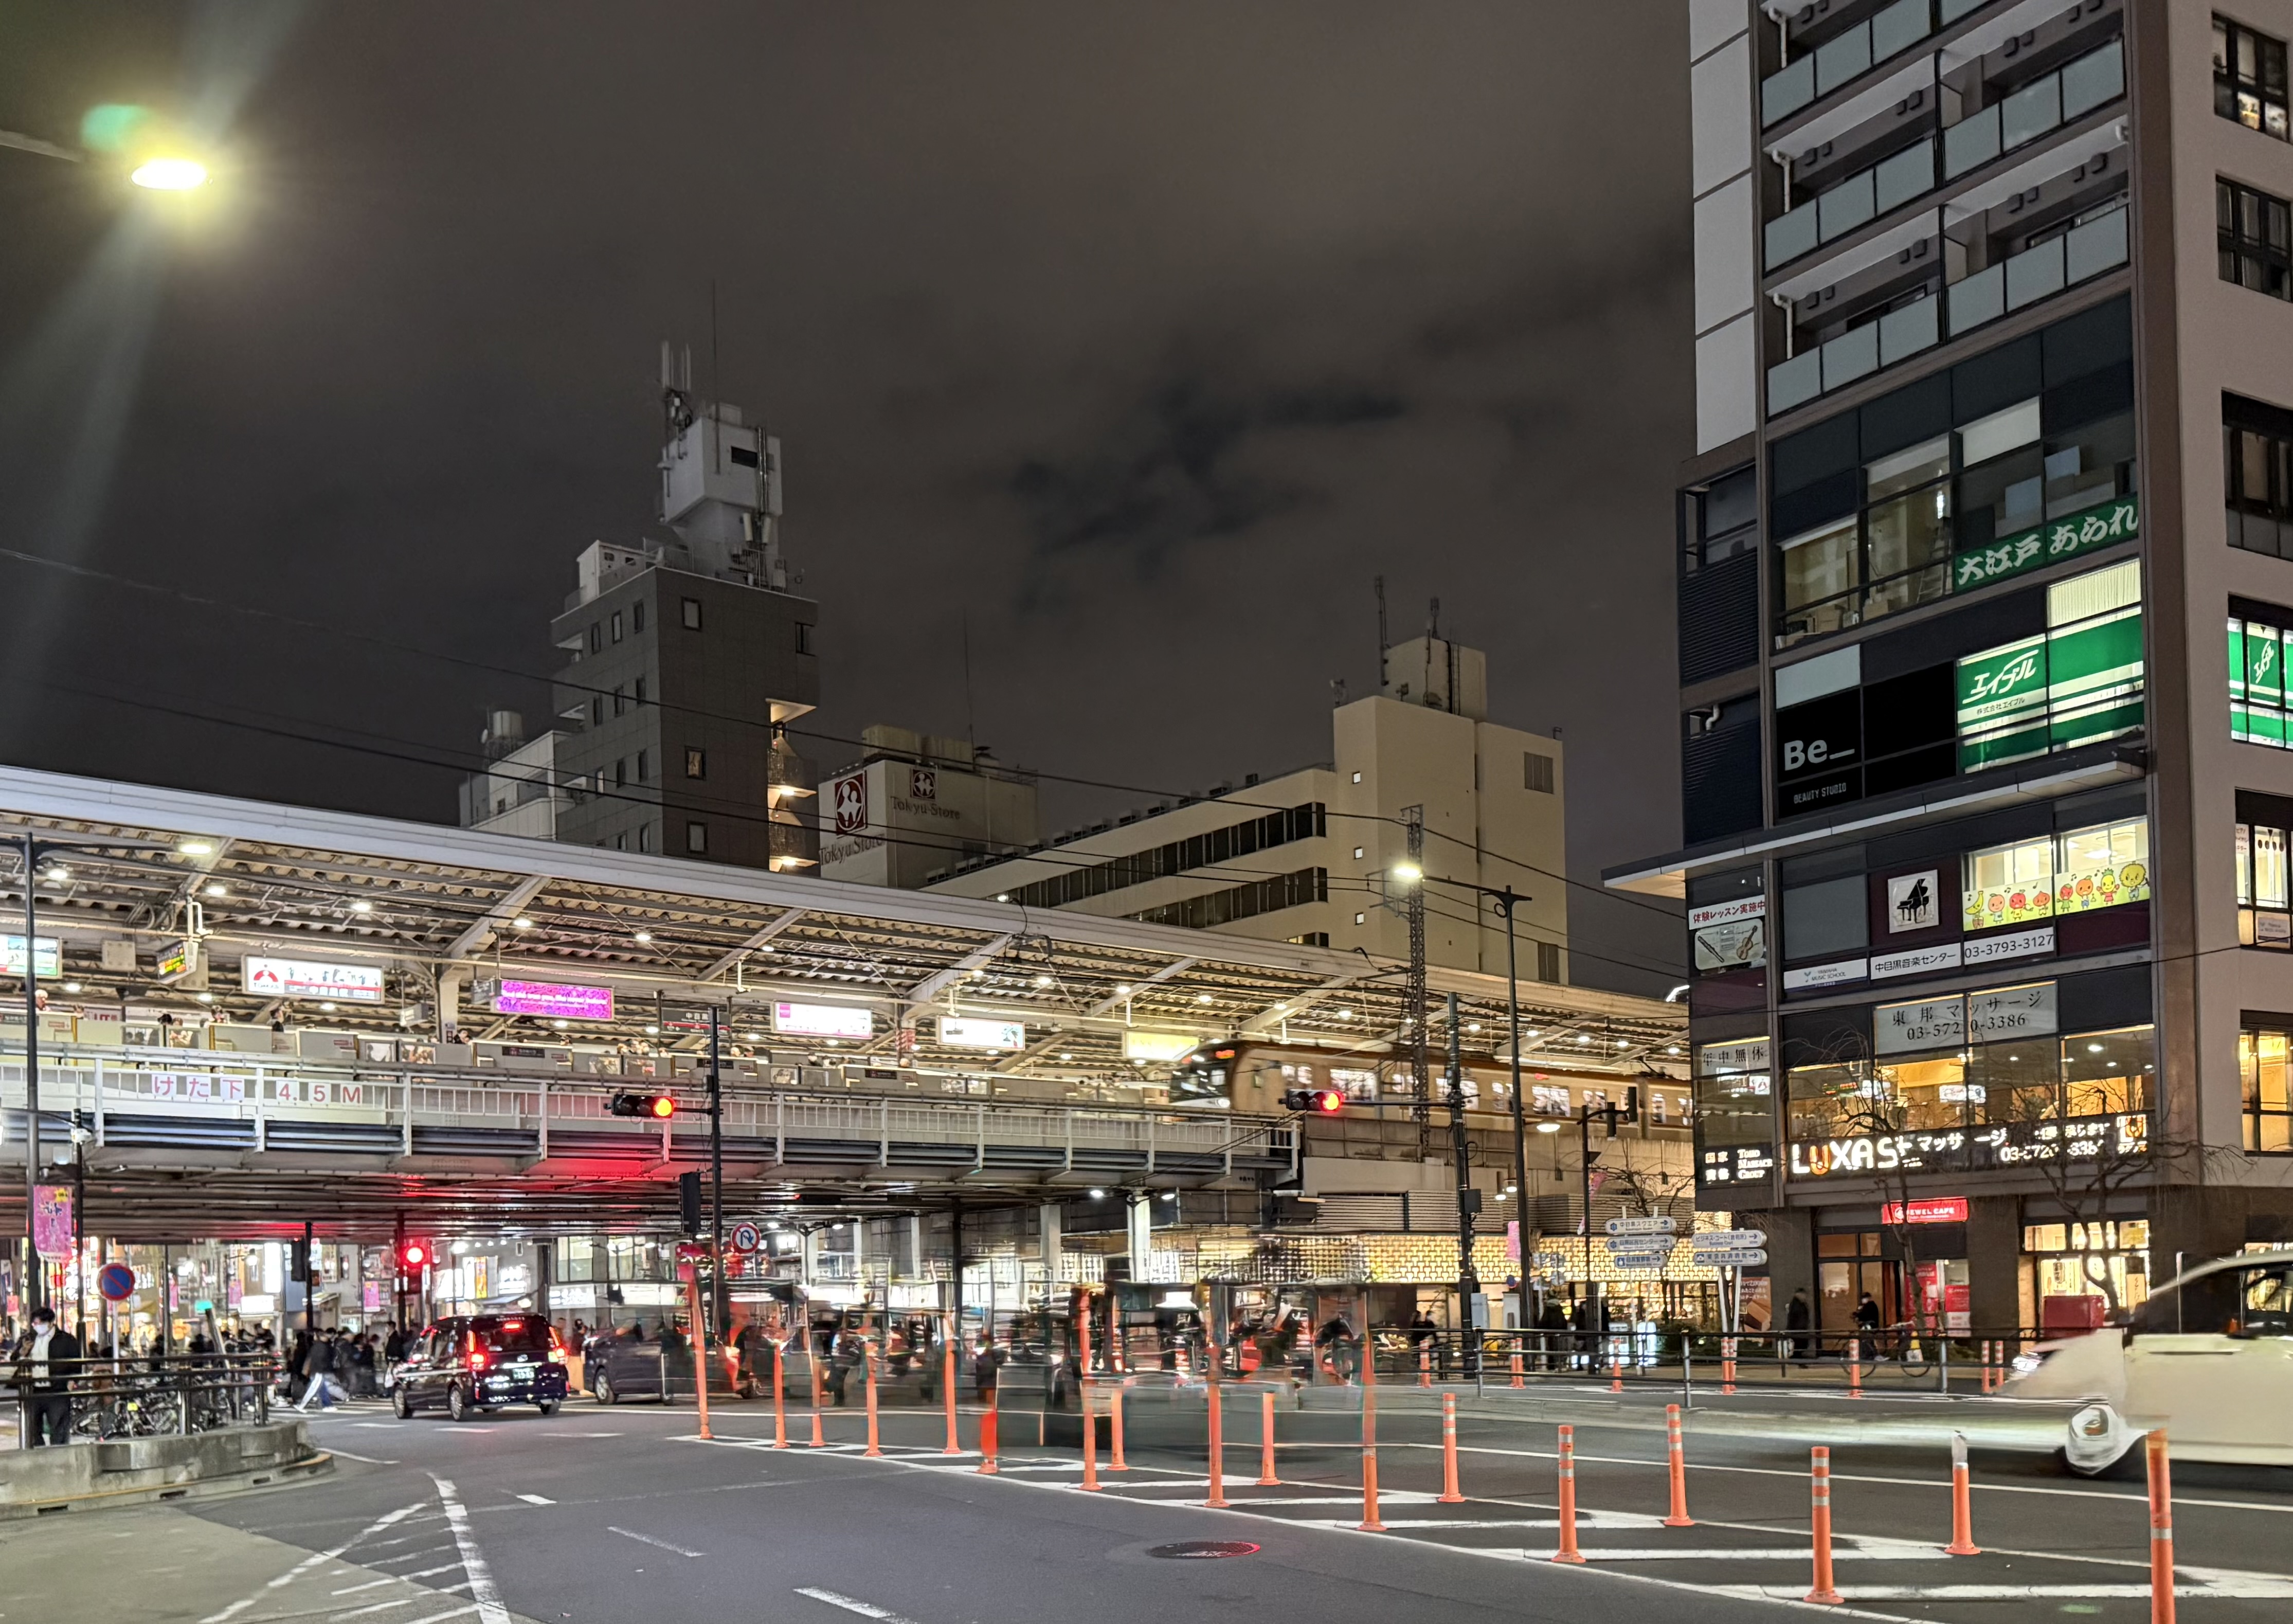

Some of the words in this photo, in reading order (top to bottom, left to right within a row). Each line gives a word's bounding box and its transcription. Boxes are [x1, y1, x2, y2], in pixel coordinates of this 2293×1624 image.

[1958, 533, 2042, 585] 大江戸
[2049, 504, 2138, 554] あられ
[2253, 640, 2274, 684] エイブル
[1962, 649, 2039, 704] エイブル
[1976, 697, 2025, 716] 株式会社エイブル
[1793, 789, 1819, 804] BEAUTY
[1821, 782, 1847, 797] STUDIO
[890, 796, 927, 816] Tokyu
[930, 803, 961, 820] Store
[820, 842, 852, 866] Tokyu
[854, 833, 886, 855] Store
[1693, 900, 1766, 924] 体験レッスン実施中
[1964, 934, 2054, 959] 03-3793-3127
[1874, 953, 1957, 972] 中目黒音楽センター
[1907, 1013, 2026, 1040] 03-5720-3386
[1703, 1045, 1764, 1067] 年中無休
[155, 1076, 243, 1099] けた下
[1792, 1136, 1899, 1176] LUXAS
